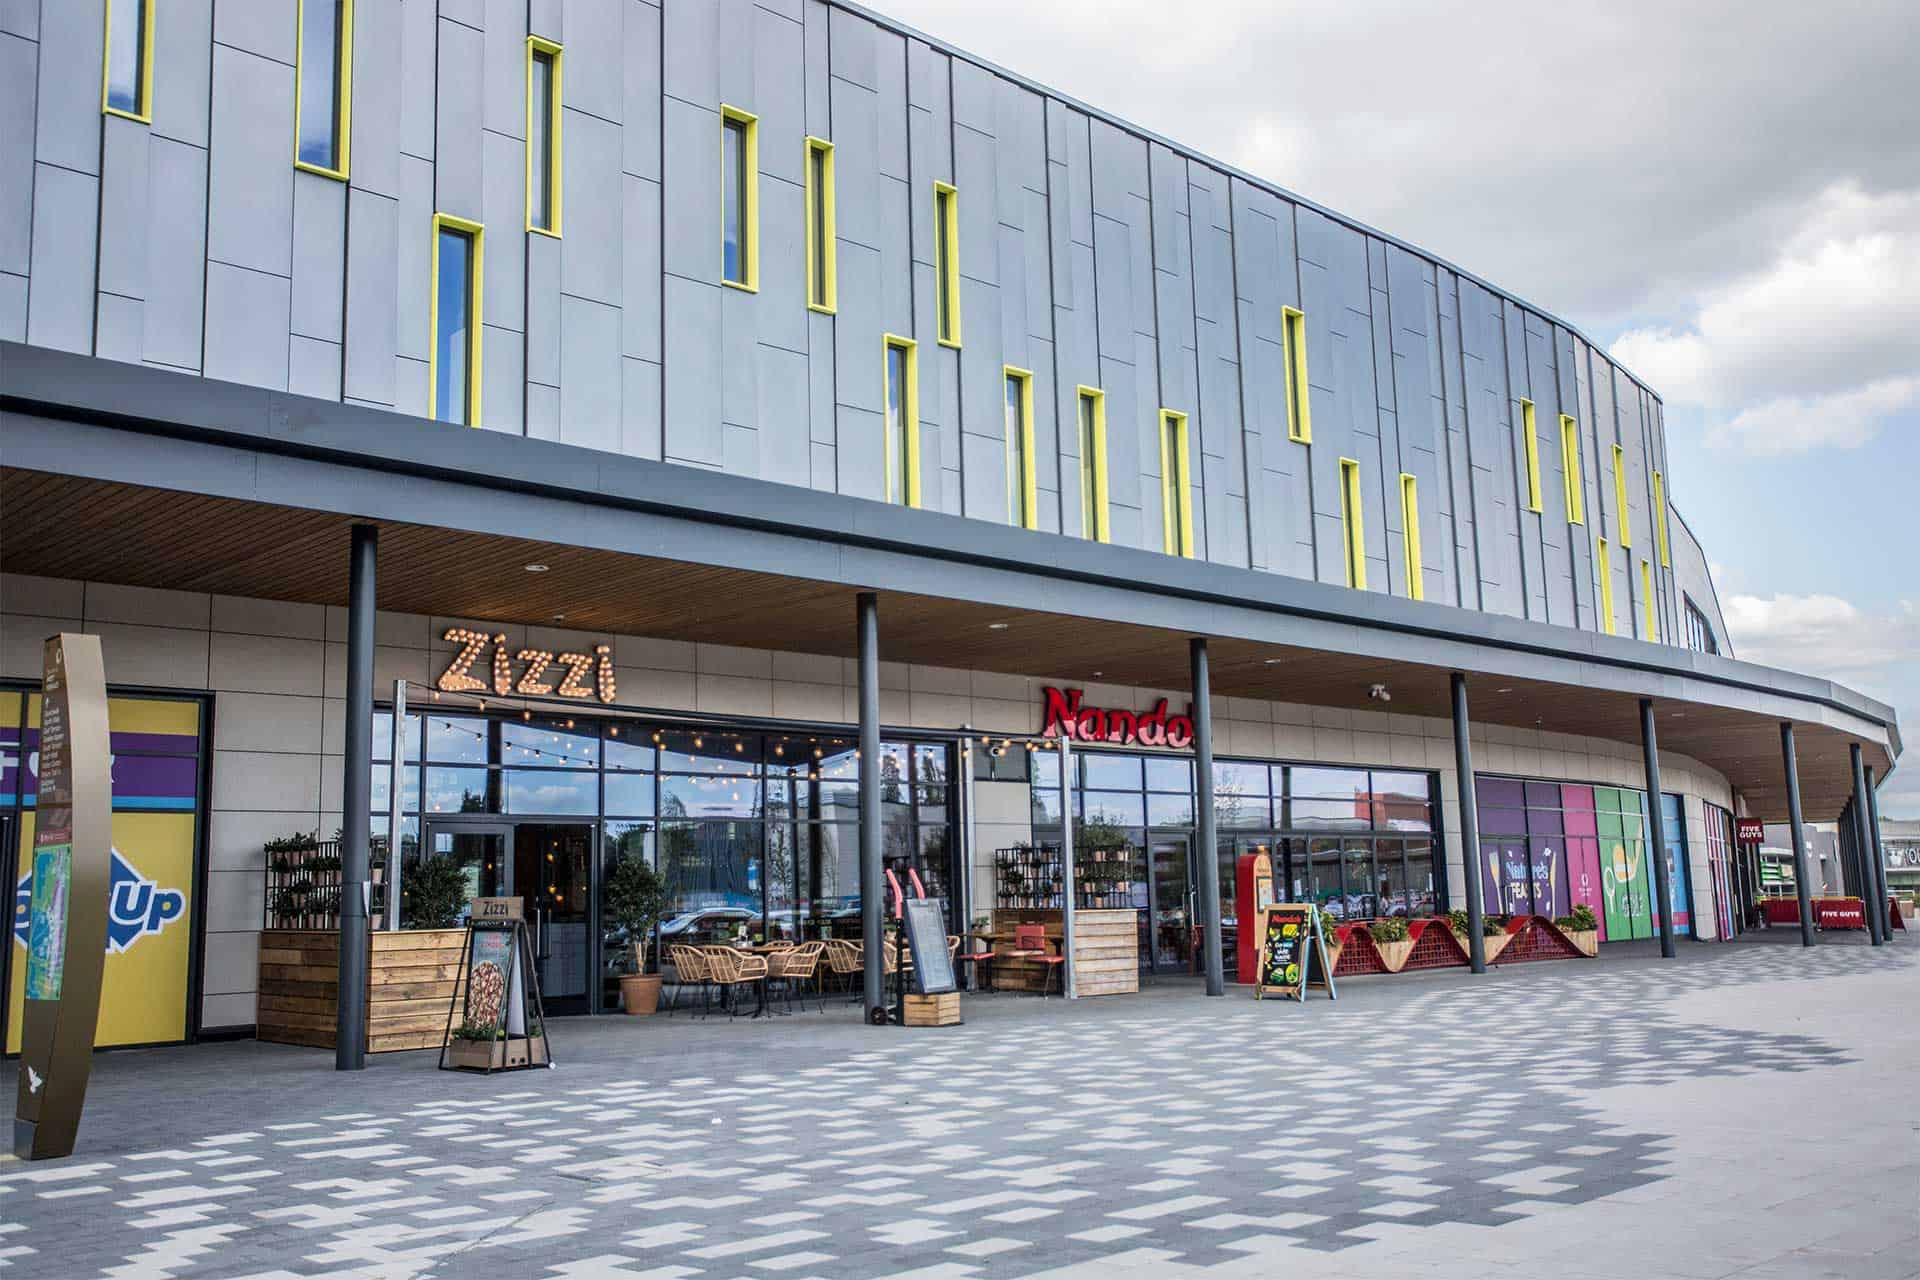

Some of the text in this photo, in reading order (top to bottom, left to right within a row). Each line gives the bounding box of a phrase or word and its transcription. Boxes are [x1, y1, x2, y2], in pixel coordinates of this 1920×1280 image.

[438, 628, 616, 703] Zizzi
[1043, 686, 1194, 748] Nando
[1739, 831, 1763, 839] GUYS
